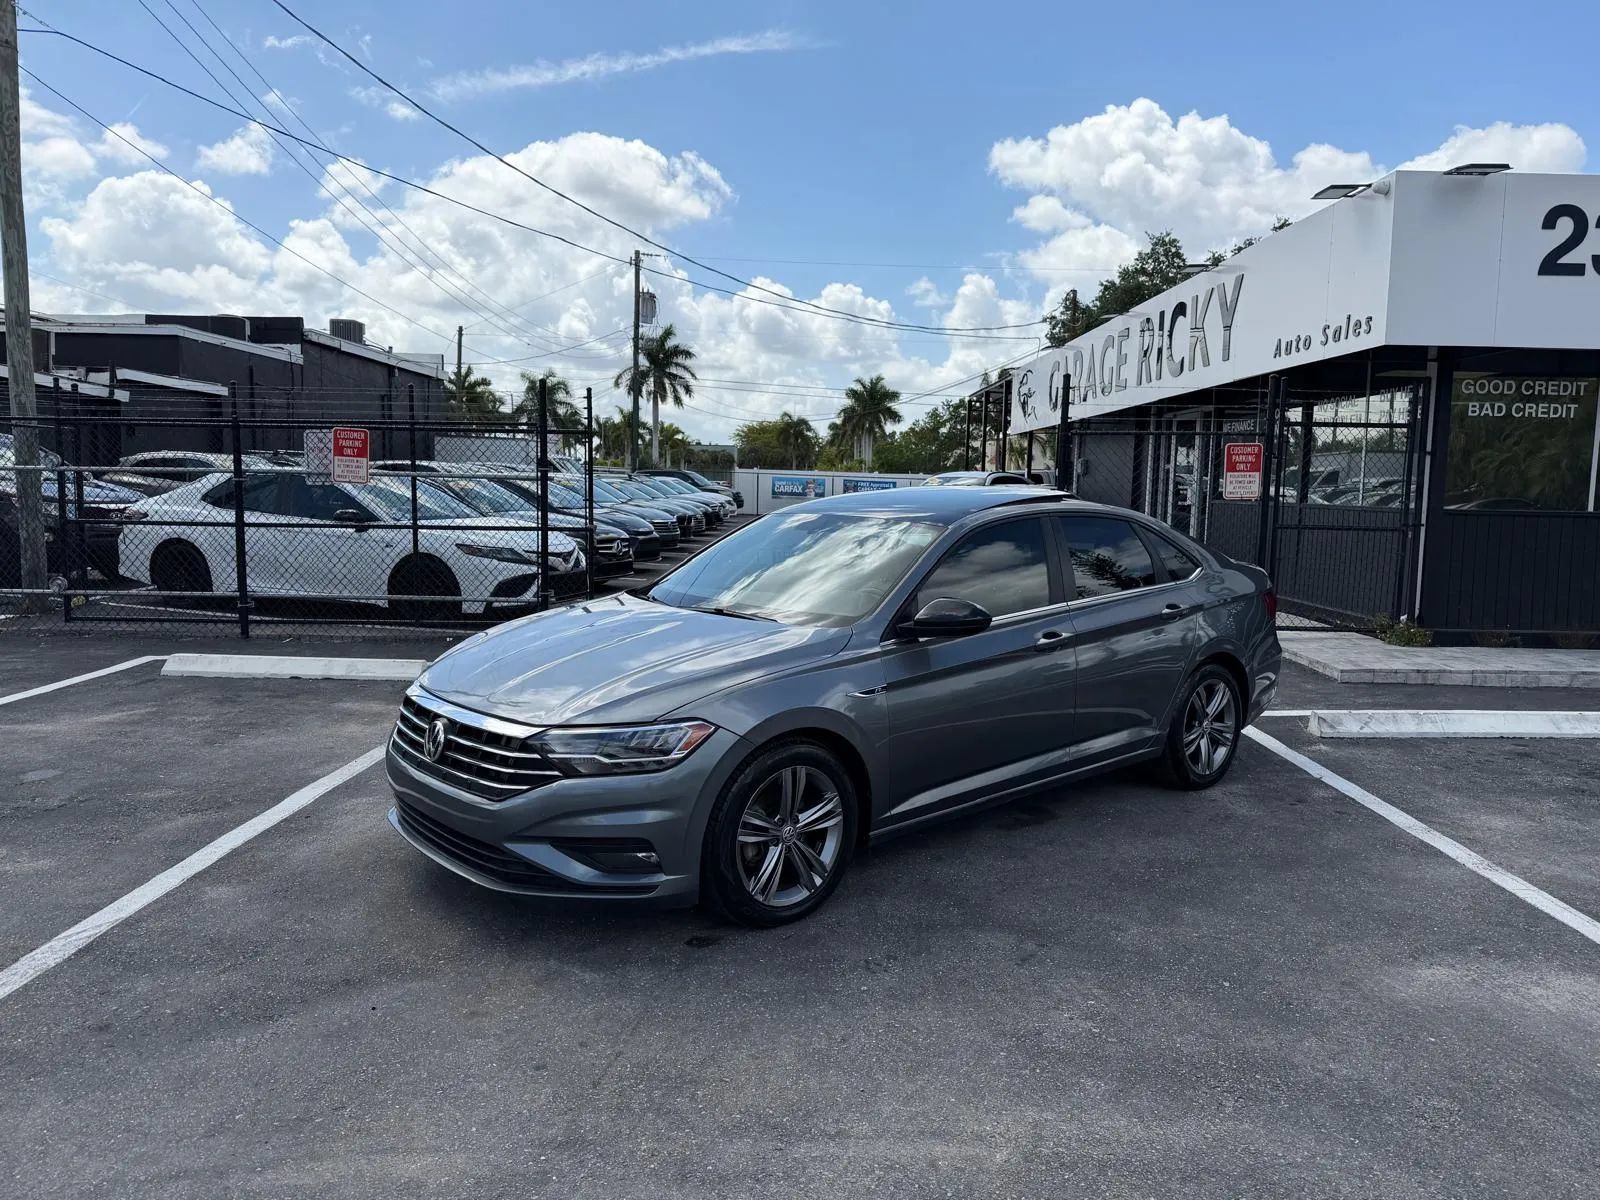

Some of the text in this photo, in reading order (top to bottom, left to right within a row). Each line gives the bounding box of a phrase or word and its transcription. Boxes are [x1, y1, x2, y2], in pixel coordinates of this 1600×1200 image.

[1538, 203, 1600, 277] 2
[1136, 273, 1245, 386] RICKY
[1273, 314, 1373, 359] Auto Sales
[1461, 379, 1589, 396] GOOD CREDIT
[1468, 402, 1578, 418] BAD CREDIT
[336, 431, 365, 440] CUSTOMER
[338, 439, 363, 447] PARKING
[1230, 446, 1258, 454] CUSTOMER
[1232, 455, 1256, 463] PARKING
[1236, 463, 1251, 471] ONLY
[774, 484, 803, 493] CARFAX
